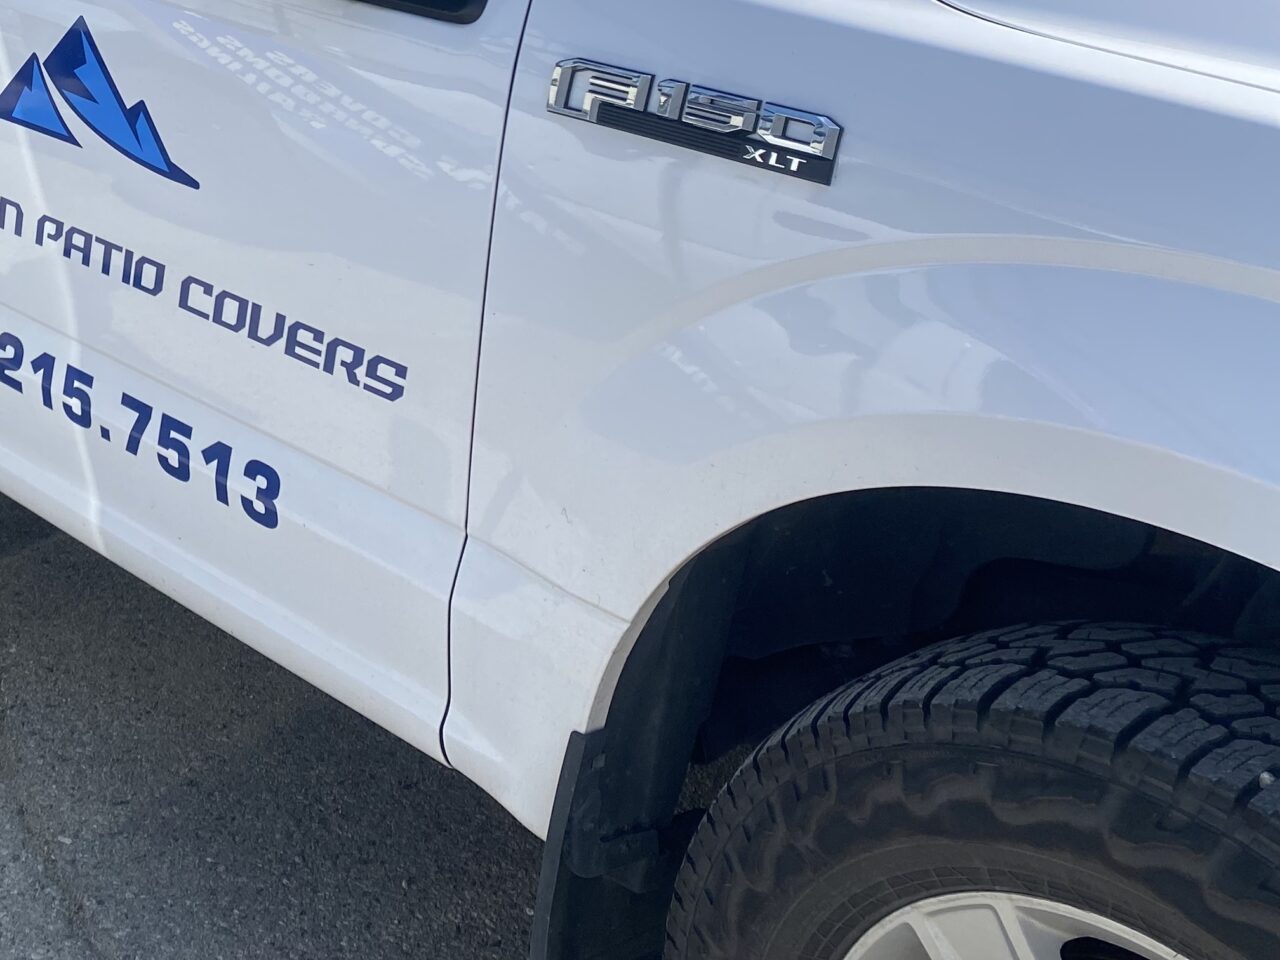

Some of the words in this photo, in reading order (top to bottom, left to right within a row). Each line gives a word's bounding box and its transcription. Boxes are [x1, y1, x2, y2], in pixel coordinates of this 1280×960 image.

[743, 145, 807, 172] XLT
[35, 214, 166, 297] PATIO
[178, 276, 408, 403] COVERS
